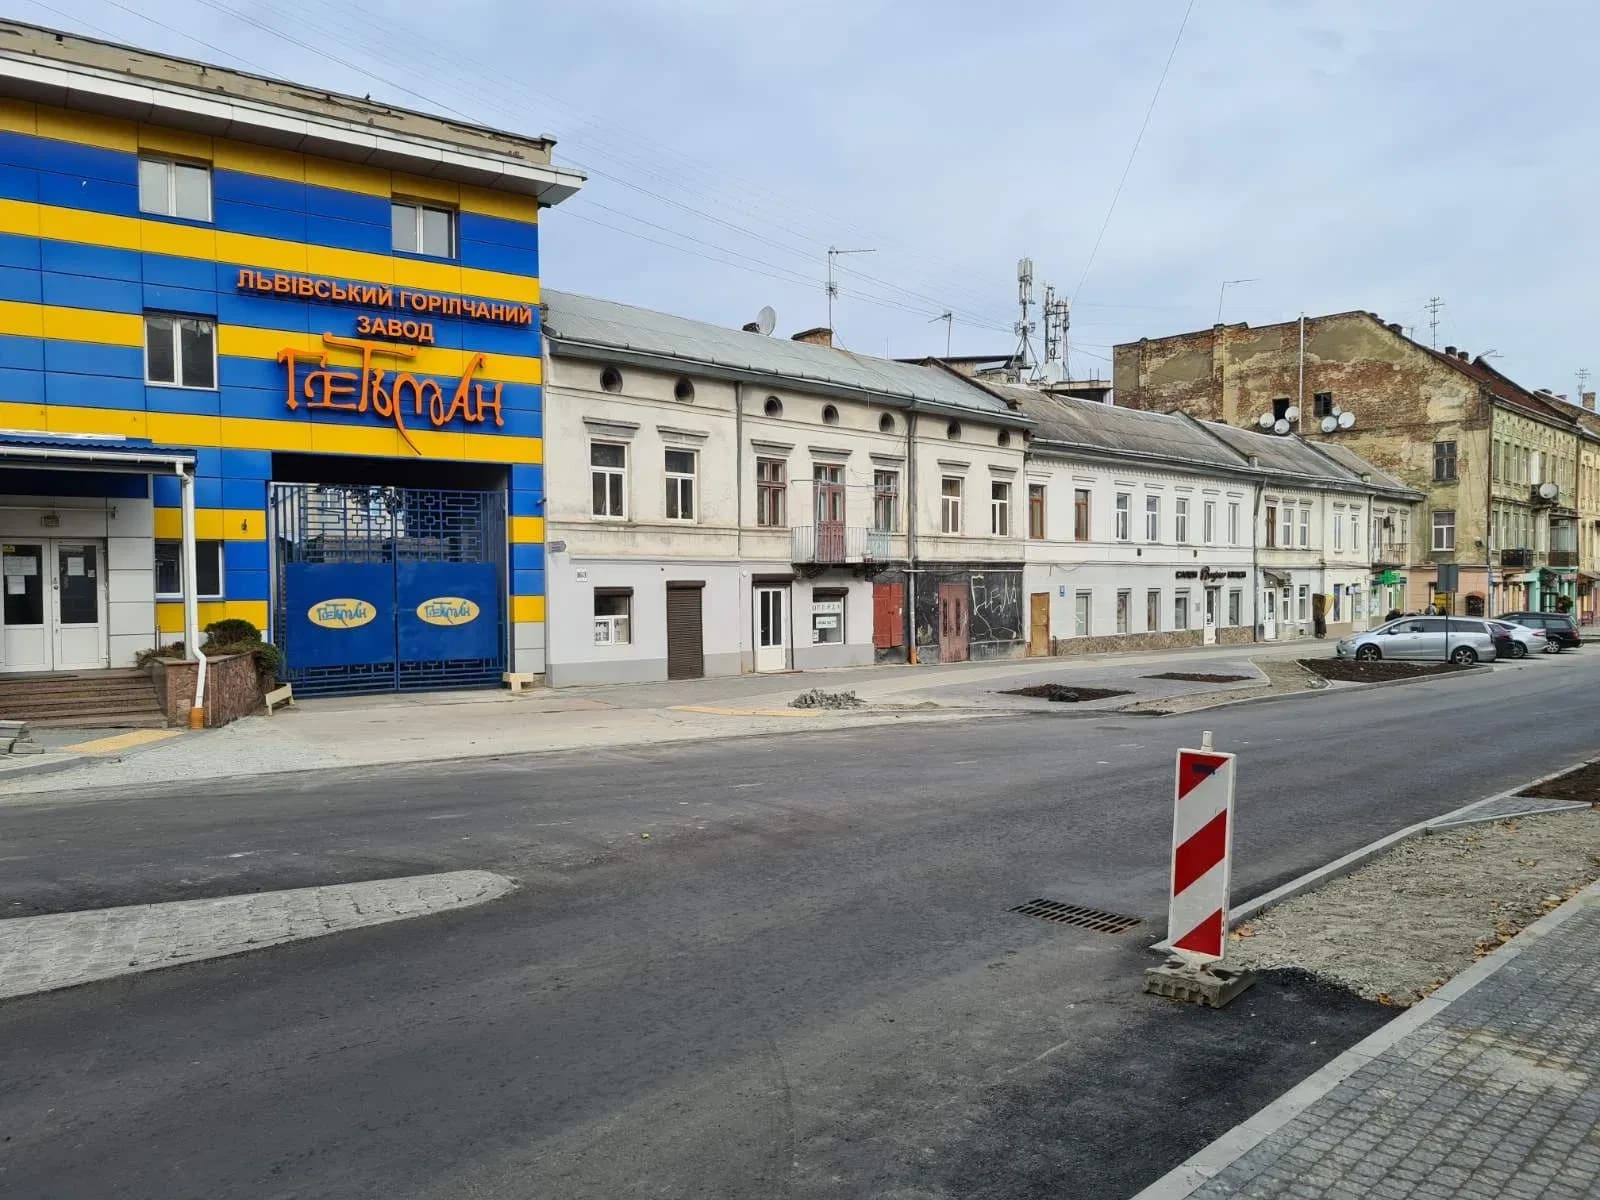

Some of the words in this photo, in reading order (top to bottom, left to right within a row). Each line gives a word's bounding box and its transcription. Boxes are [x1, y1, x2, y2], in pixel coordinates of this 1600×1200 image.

[237, 269, 394, 308] ЛЬВІВСЬКИЙ
[399, 290, 532, 325] ГОРІЛЧАНИЙ
[356, 315, 435, 343] ЗАВОД
